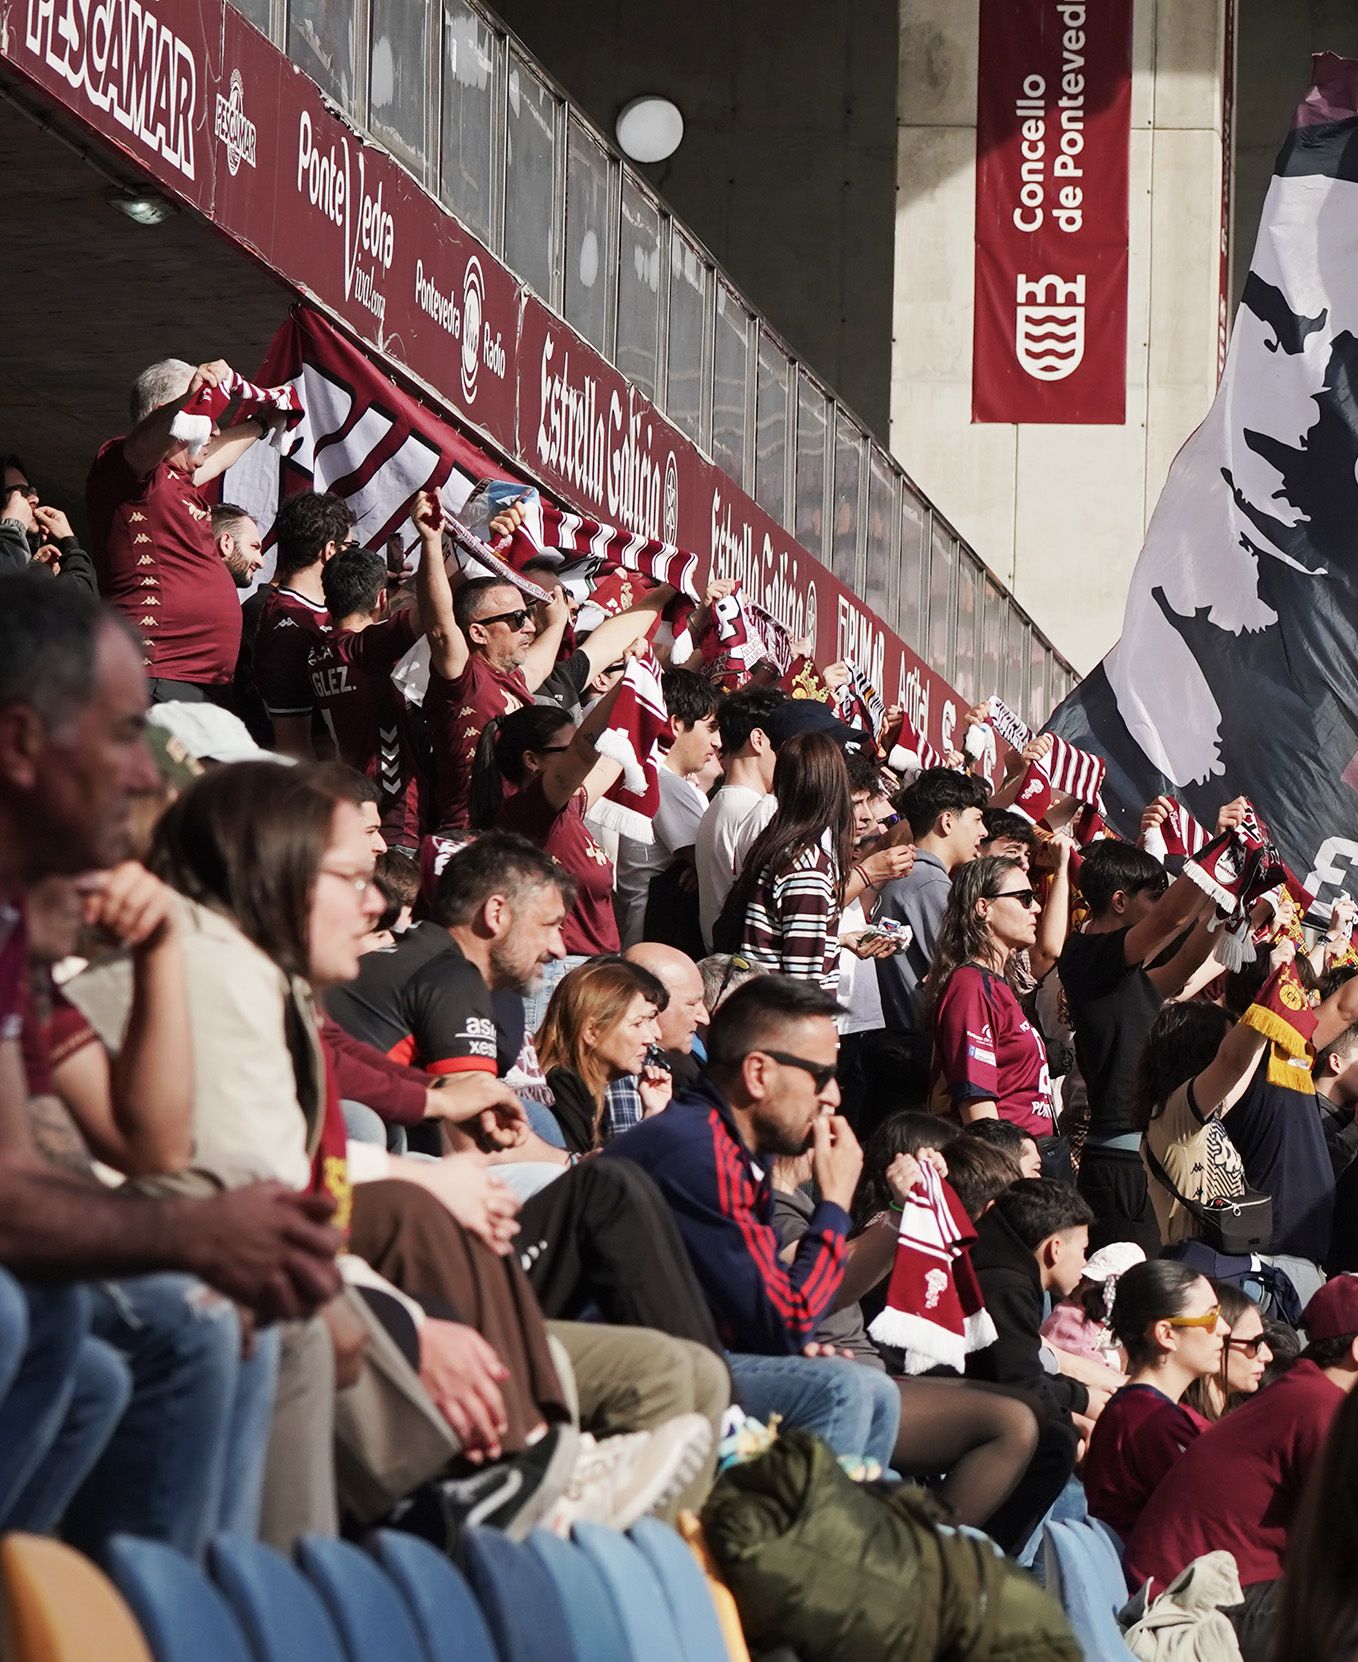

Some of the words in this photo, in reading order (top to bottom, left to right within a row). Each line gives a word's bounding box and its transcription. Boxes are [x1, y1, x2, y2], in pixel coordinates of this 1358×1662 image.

[1013, 74, 1046, 232] Concello
[1052, 185, 1083, 233] de
[415, 259, 460, 339] Pontevedra
[484, 321, 506, 379] Radio
[537, 331, 605, 507] Estrella
[607, 384, 661, 541] Galicia
[311, 665, 358, 698] GLEZ.
